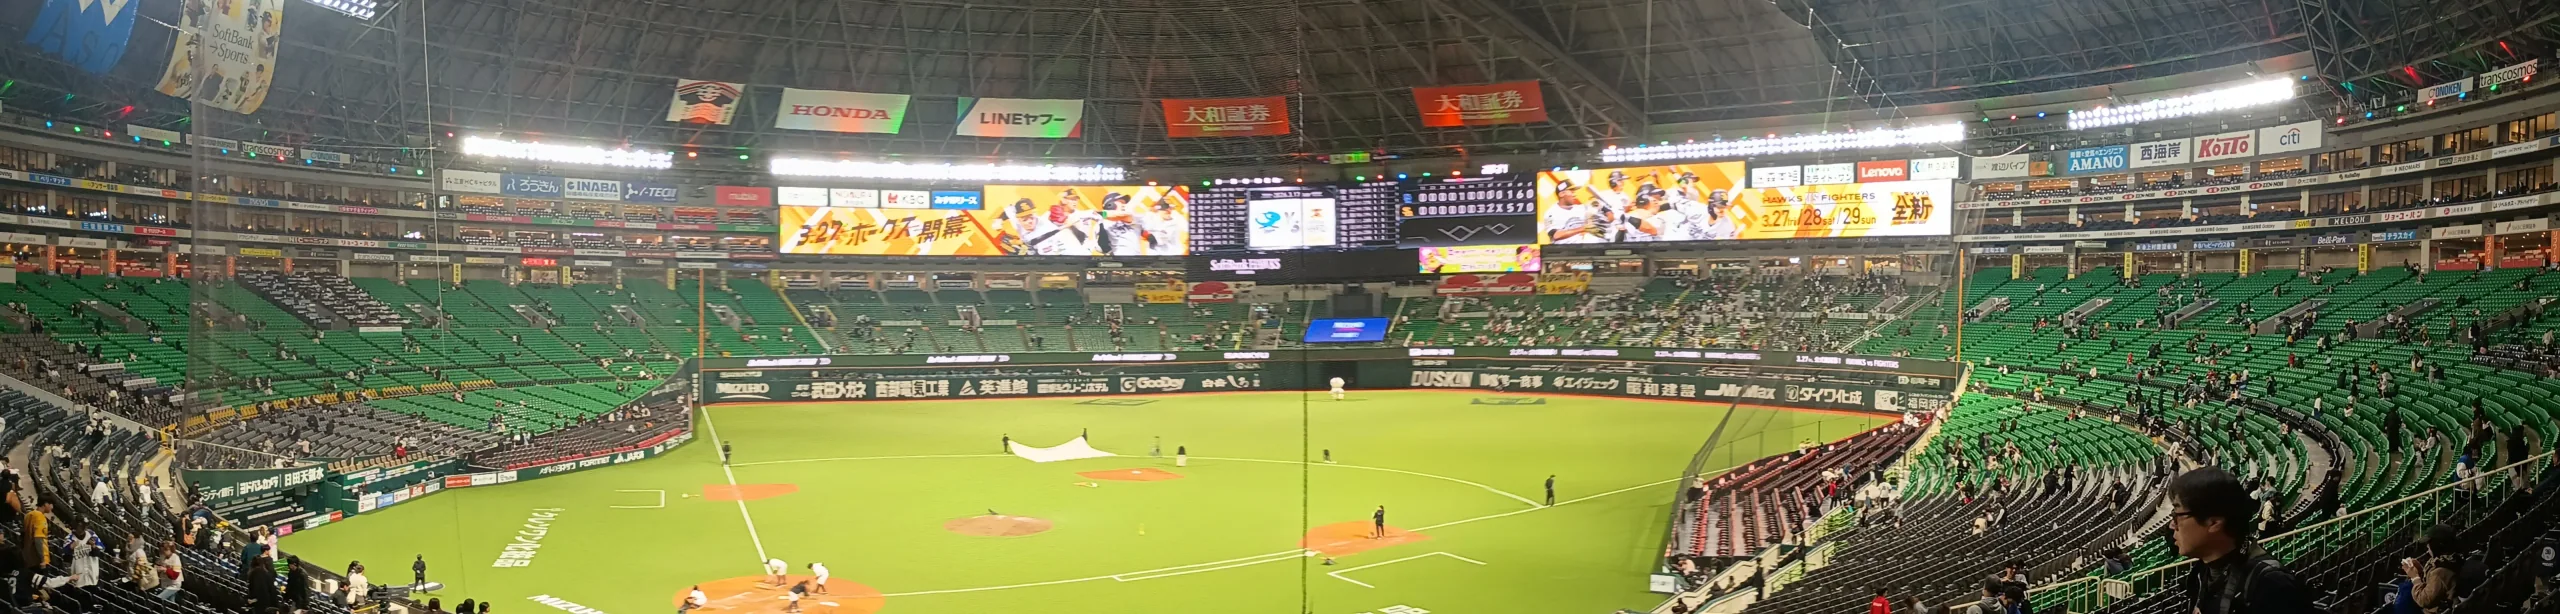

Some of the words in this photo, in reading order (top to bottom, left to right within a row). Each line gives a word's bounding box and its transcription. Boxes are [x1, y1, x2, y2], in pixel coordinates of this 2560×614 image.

[213, 24, 254, 49] SoftBank
[217, 43, 249, 64] Sports
[2480, 63, 2537, 87] transcosmos
[1434, 90, 1523, 111] 大和証券
[789, 105, 891, 120] HONDA
[980, 112, 1066, 125] LINEヤフー
[1182, 105, 1270, 122] 大和証券
[2280, 131, 2300, 146] citi
[243, 144, 294, 156] transcosmos
[2140, 142, 2182, 161] 西海岸
[2070, 156, 2123, 171] AMANO
[1861, 167, 1904, 178] Lenovo
[520, 176, 559, 193] ろうきん
[577, 181, 618, 193] INABA
[1763, 195, 1803, 204] HAWKS
[1821, 192, 1876, 201] FIGHTERS
[1892, 195, 1933, 221] 全新
[2387, 231, 2412, 240] テラスカイ
[979, 379, 1028, 395] 英進館
[1411, 371, 1473, 387] DUSKIN
[875, 380, 950, 398] 西部電気工業
[1626, 382, 1696, 398] 昭和建設
[1799, 388, 1863, 405] ダイワ化成
[284, 466, 324, 487] 日田天領水
